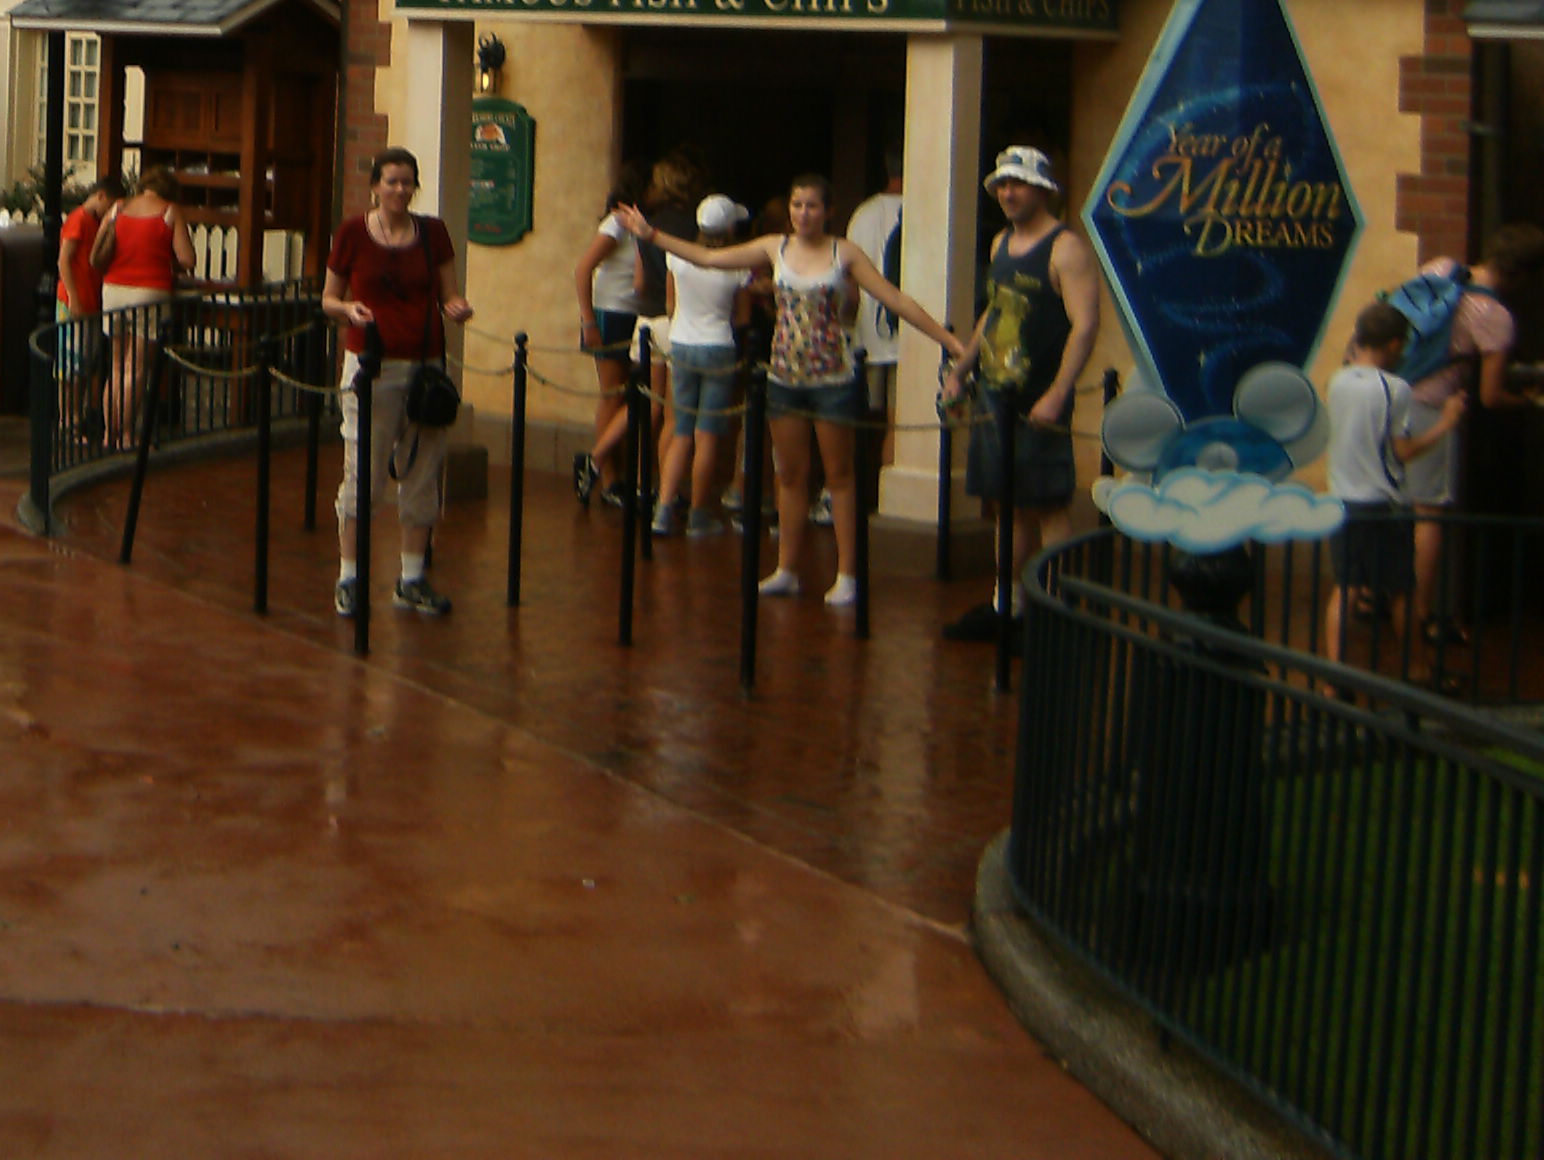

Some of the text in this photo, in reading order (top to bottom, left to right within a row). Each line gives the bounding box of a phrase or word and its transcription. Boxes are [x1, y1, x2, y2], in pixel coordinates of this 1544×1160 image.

[1157, 117, 1283, 176] Year of a
[1107, 155, 1341, 220] Million
[1182, 206, 1335, 257] DREAMS
